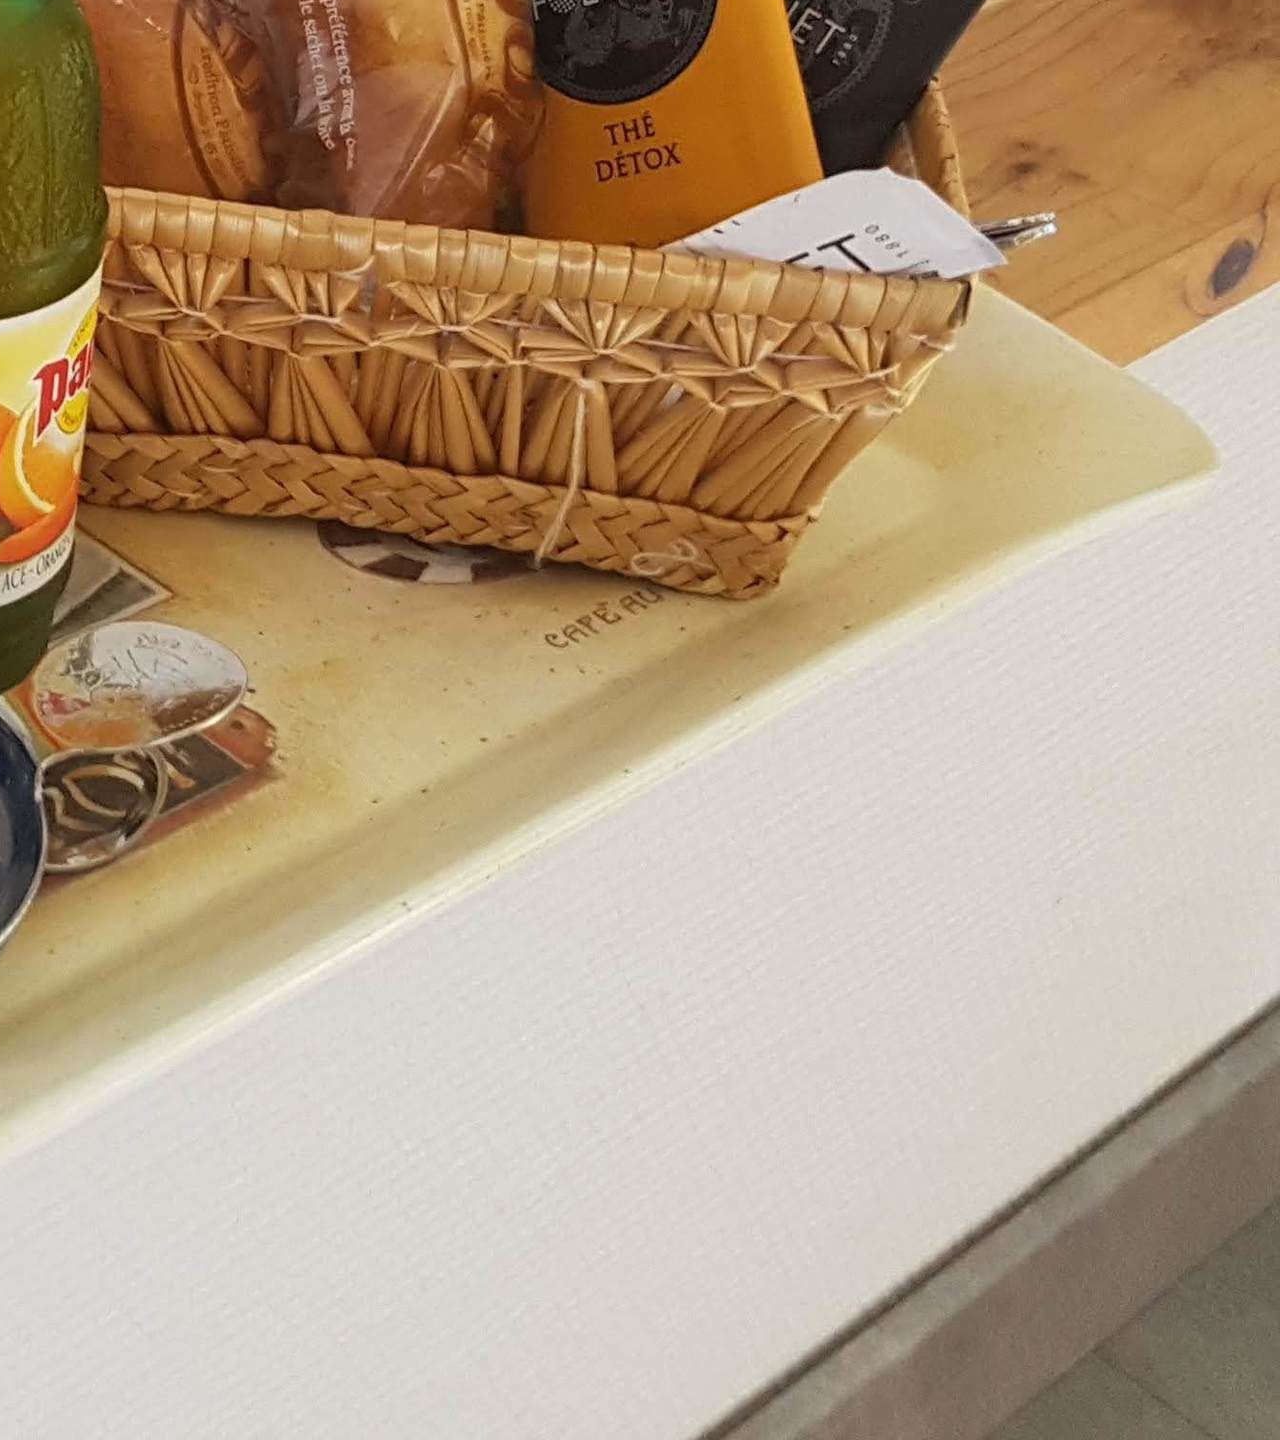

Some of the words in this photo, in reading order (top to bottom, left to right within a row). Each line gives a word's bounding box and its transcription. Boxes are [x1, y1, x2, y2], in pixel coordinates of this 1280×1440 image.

[304, 17, 325, 73] sachet
[603, 110, 656, 146] THÉ
[594, 142, 682, 183] DÉTOX
